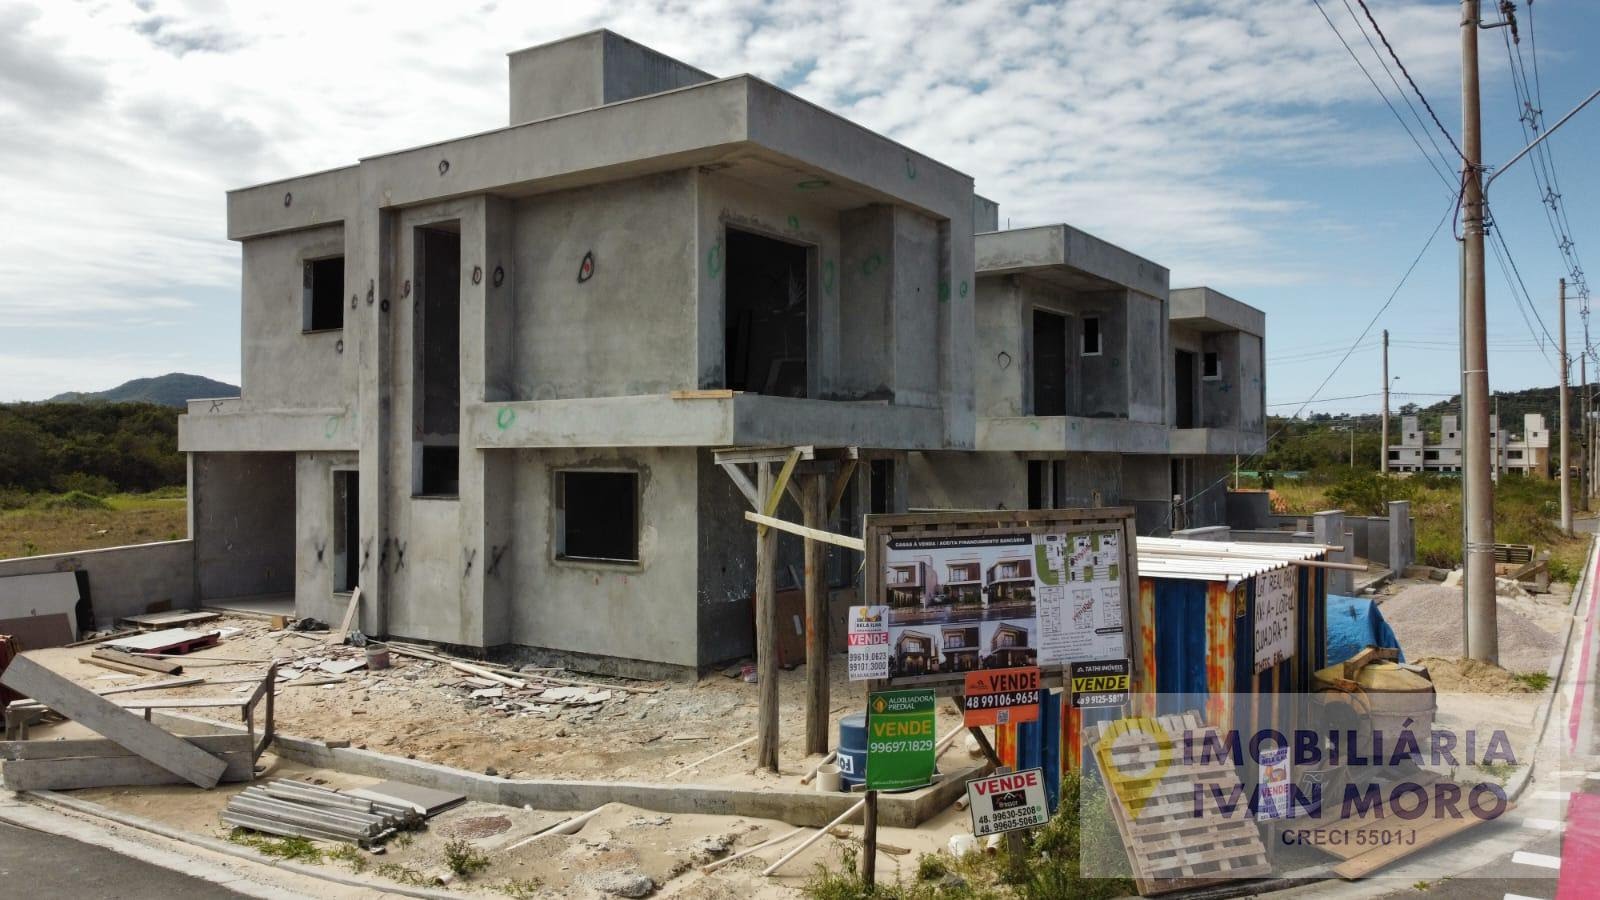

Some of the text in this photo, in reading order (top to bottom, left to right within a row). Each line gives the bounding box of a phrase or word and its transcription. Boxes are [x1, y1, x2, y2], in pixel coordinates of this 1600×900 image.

[850, 633, 888, 645] VENDE
[989, 672, 1036, 691] VENDE
[1074, 676, 1127, 691] VENDE
[888, 695, 934, 704] AUXILIADORA
[966, 691, 1039, 708] 48 99106-9654
[873, 720, 932, 737] VENDE
[870, 740, 933, 753] 99697.1829
[974, 772, 1038, 796] VENDE
[1262, 784, 1289, 797] VENDE
